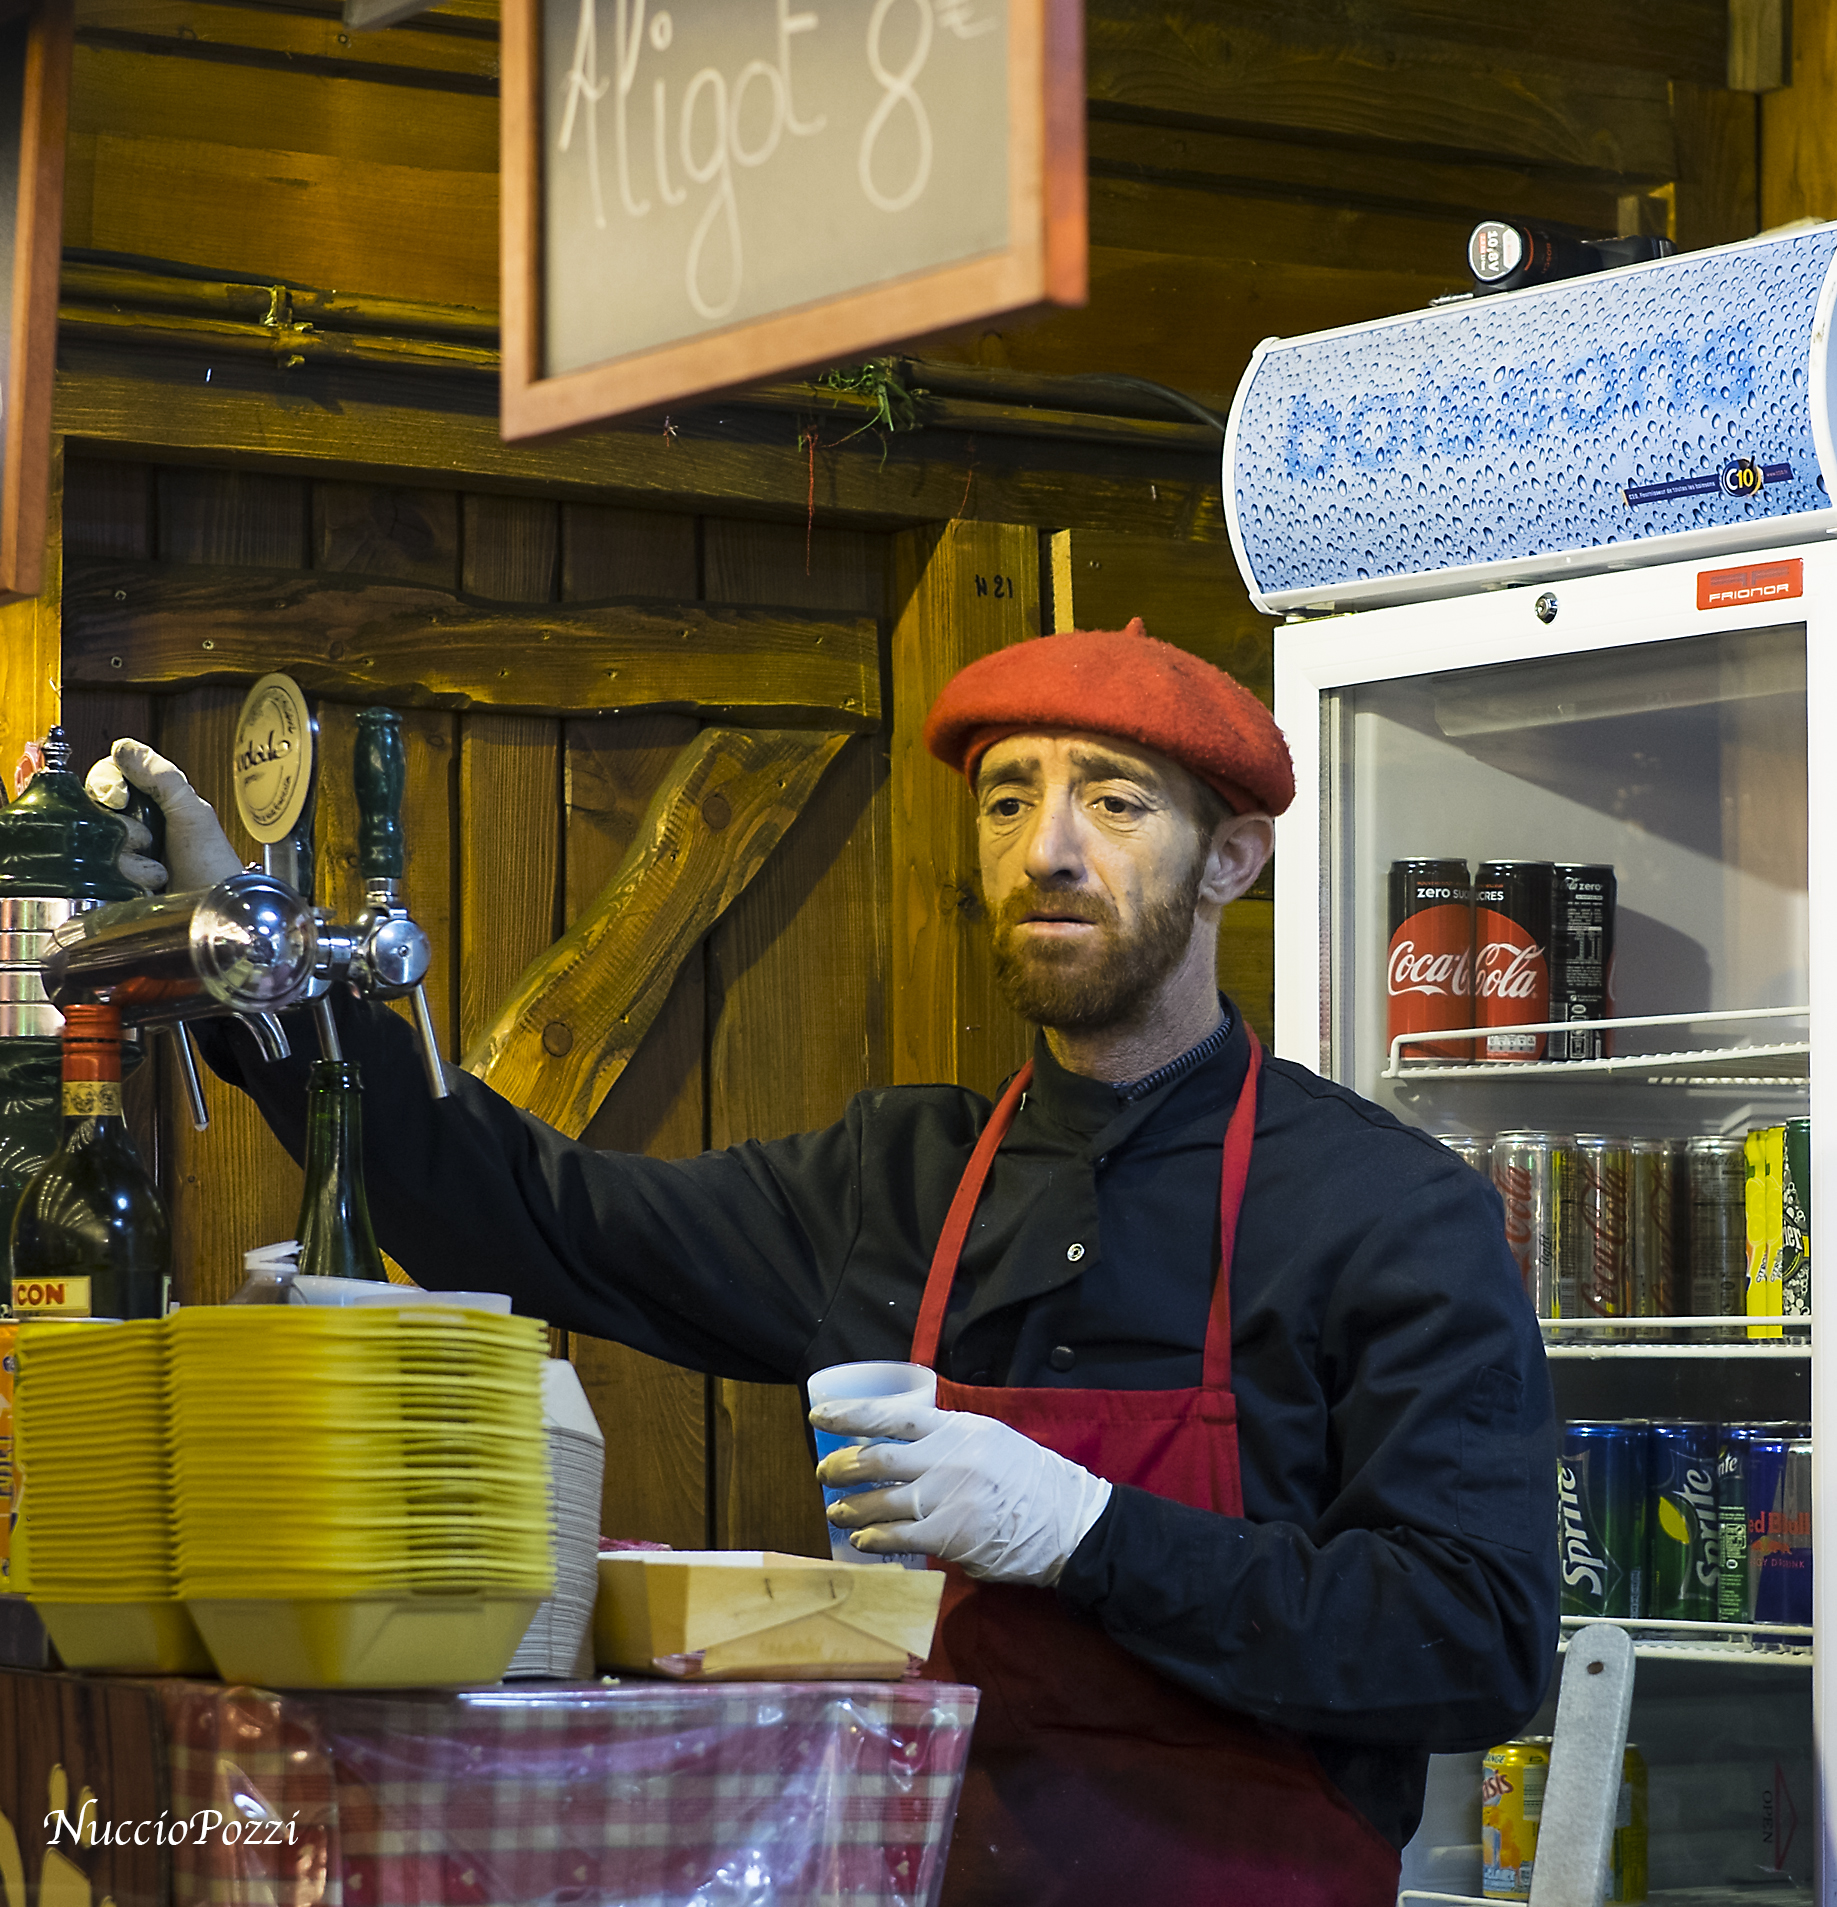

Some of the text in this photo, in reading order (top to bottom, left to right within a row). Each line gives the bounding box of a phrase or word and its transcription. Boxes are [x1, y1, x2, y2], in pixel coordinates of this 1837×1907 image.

[558, 0, 827, 319] Aligot
[1726, 468, 1754, 491] C10
[993, 574, 1014, 598] 21
[1709, 583, 1789, 602] FRIONOR
[1417, 887, 1451, 898] zero
[1562, 1466, 1609, 1597] Sprite
[1762, 1790, 1773, 1844] OPEN
